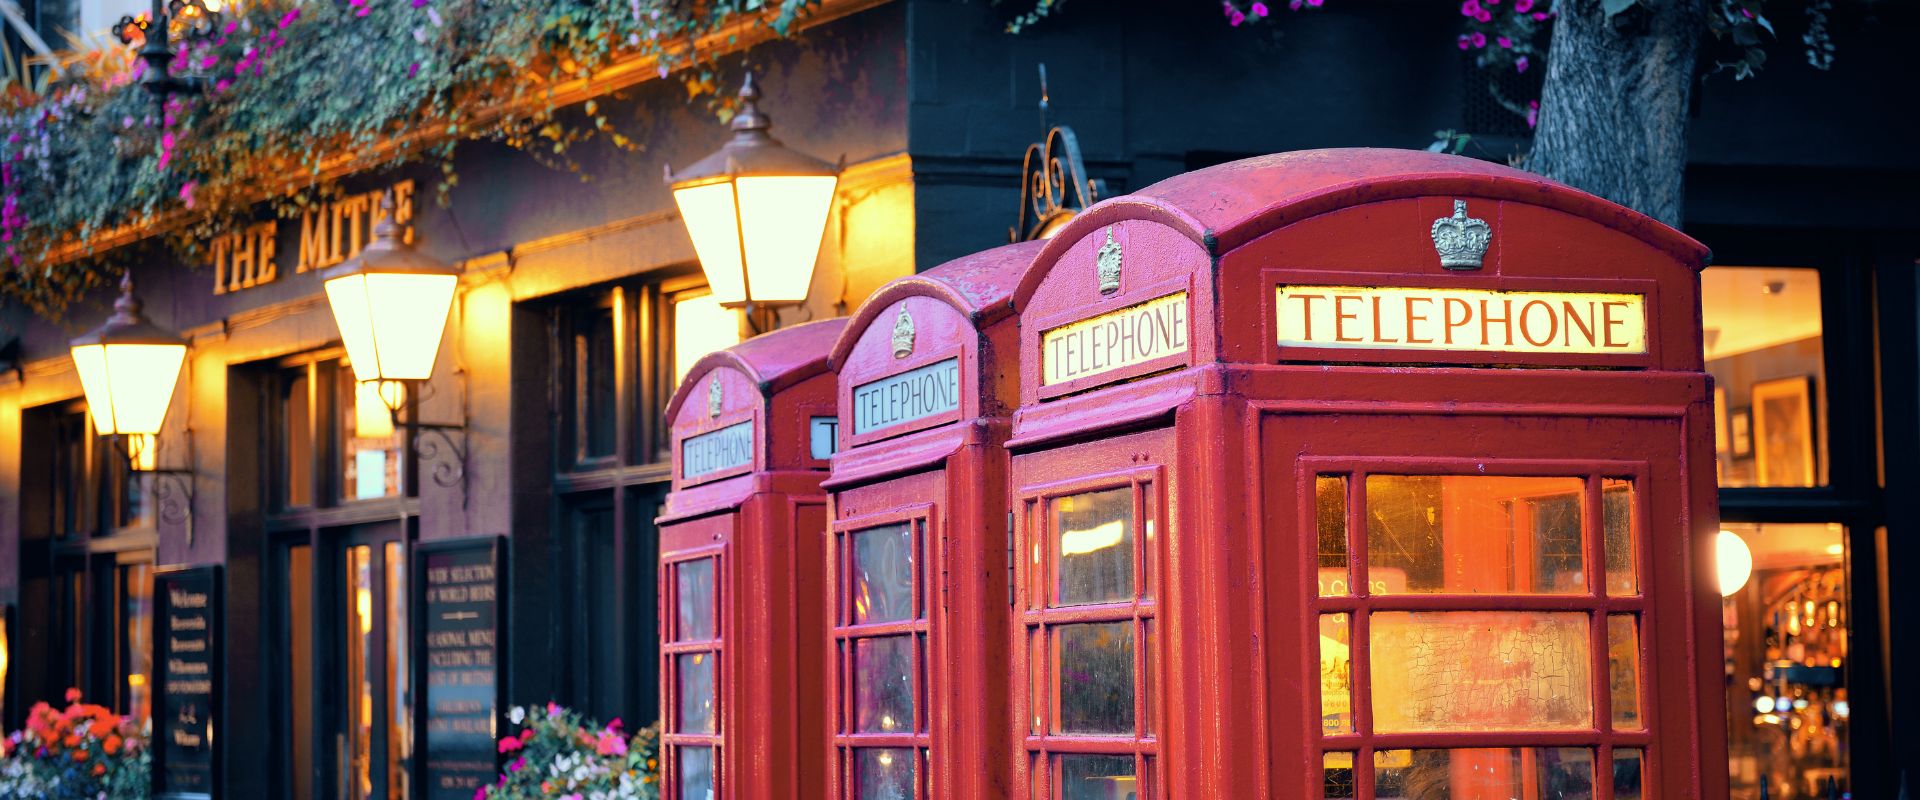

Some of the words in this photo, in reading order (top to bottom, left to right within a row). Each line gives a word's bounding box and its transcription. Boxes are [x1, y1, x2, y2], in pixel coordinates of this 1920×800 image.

[210, 219, 277, 295] THE
[1049, 301, 1186, 379] TELEPHONE
[1287, 294, 1633, 348] TELEPHONE
[859, 364, 957, 428] TELEPHONE
[686, 428, 752, 475] TELEPHONE
